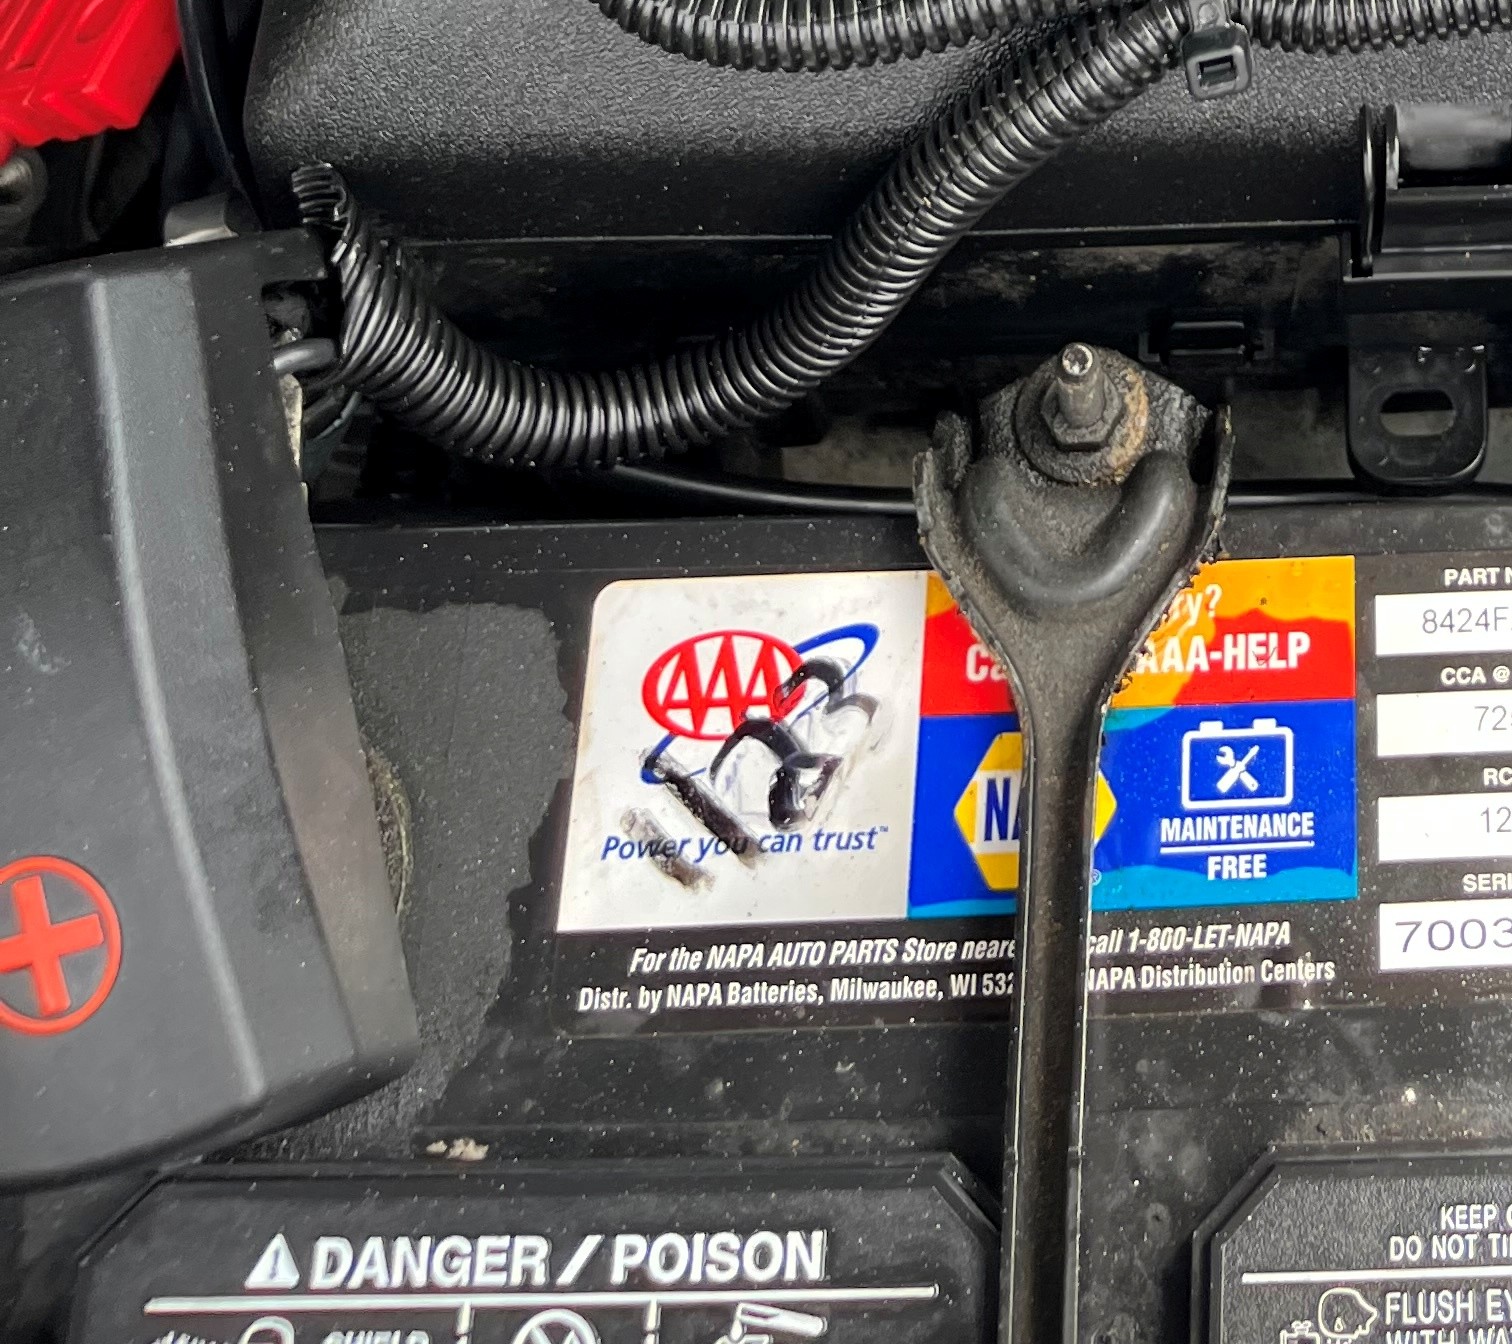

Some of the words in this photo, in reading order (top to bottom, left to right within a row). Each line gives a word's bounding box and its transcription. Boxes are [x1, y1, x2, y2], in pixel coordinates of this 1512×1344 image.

[1444, 568, 1498, 586] PART
[1134, 632, 1310, 674] AAA-HELP
[1440, 667, 1485, 685] CCA
[1492, 665, 1510, 683] @
[1160, 812, 1315, 842] MAINTENANCE
[759, 836, 802, 854] can
[1207, 854, 1267, 880] FREE
[1128, 920, 1291, 953] 1-800-LET-NAPA
[629, 948, 665, 973] For
[667, 945, 701, 971] the
[704, 944, 765, 970] NAPA
[767, 941, 825, 967] AUTO
[829, 938, 899, 964] PARTS
[901, 937, 957, 962] Store
[961, 939, 1016, 961] neare
[1140, 962, 1256, 989] Distribution
[1261, 958, 1336, 983] Centers
[577, 985, 632, 1011] Distr.
[638, 985, 662, 1013] by
[666, 982, 723, 1009] NAPA
[726, 977, 824, 1006] Batteries,
[829, 975, 944, 1002] Milwaukee,
[949, 973, 977, 997] WI
[1440, 1202, 1498, 1230] KEEP
[310, 1234, 548, 1289] DANGER
[610, 1229, 826, 1286] POISON
[1389, 1234, 1422, 1261] DO
[1431, 1232, 1478, 1260] NOT
[1385, 1288, 1474, 1325] FLUSH
